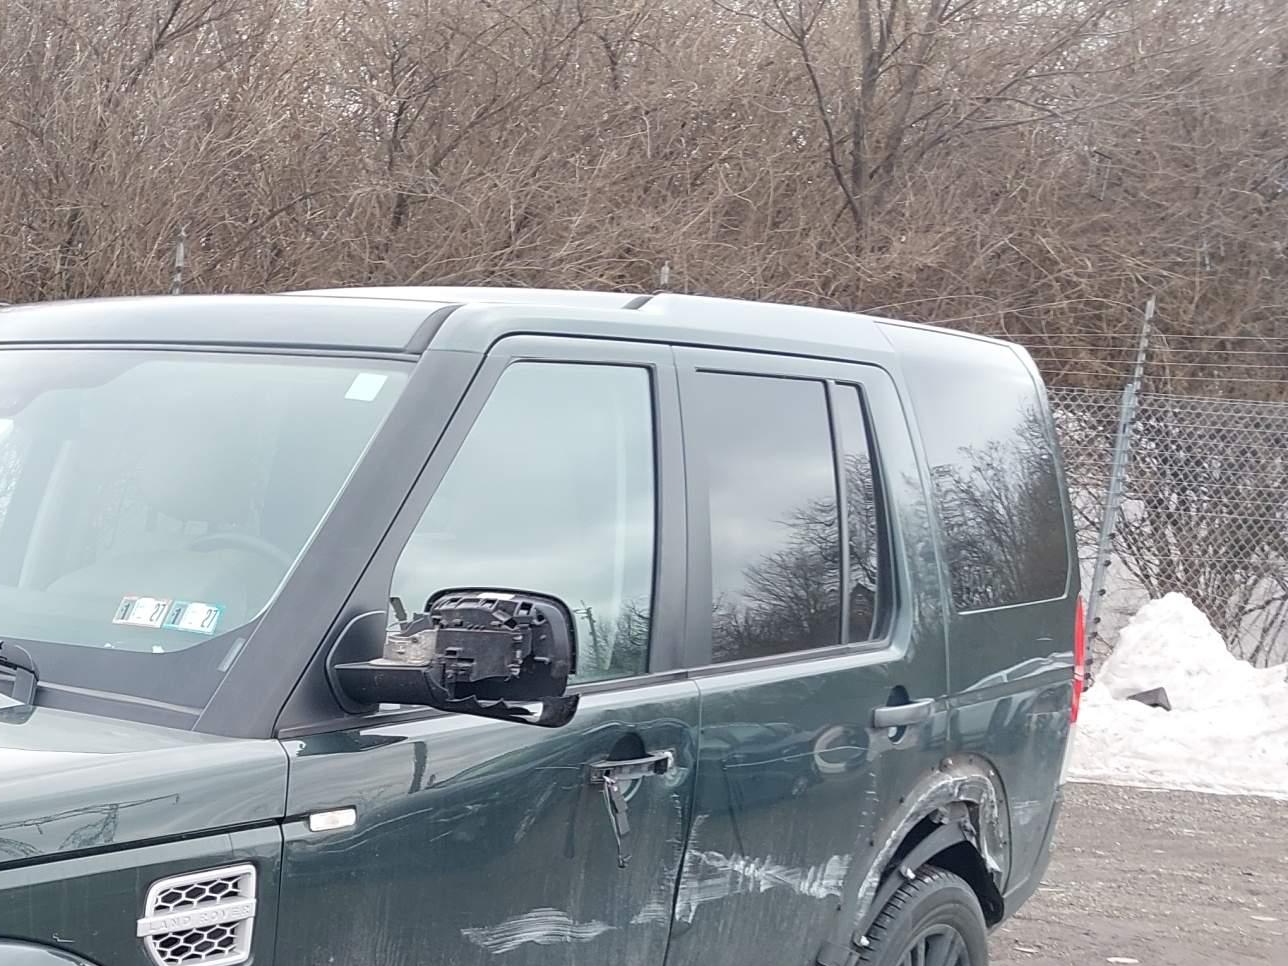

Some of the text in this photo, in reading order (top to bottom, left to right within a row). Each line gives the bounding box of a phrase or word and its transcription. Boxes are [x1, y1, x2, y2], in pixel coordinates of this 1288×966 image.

[149, 602, 168, 622] 27
[200, 608, 218, 628] 27
[149, 904, 251, 933] LAND ROVER
